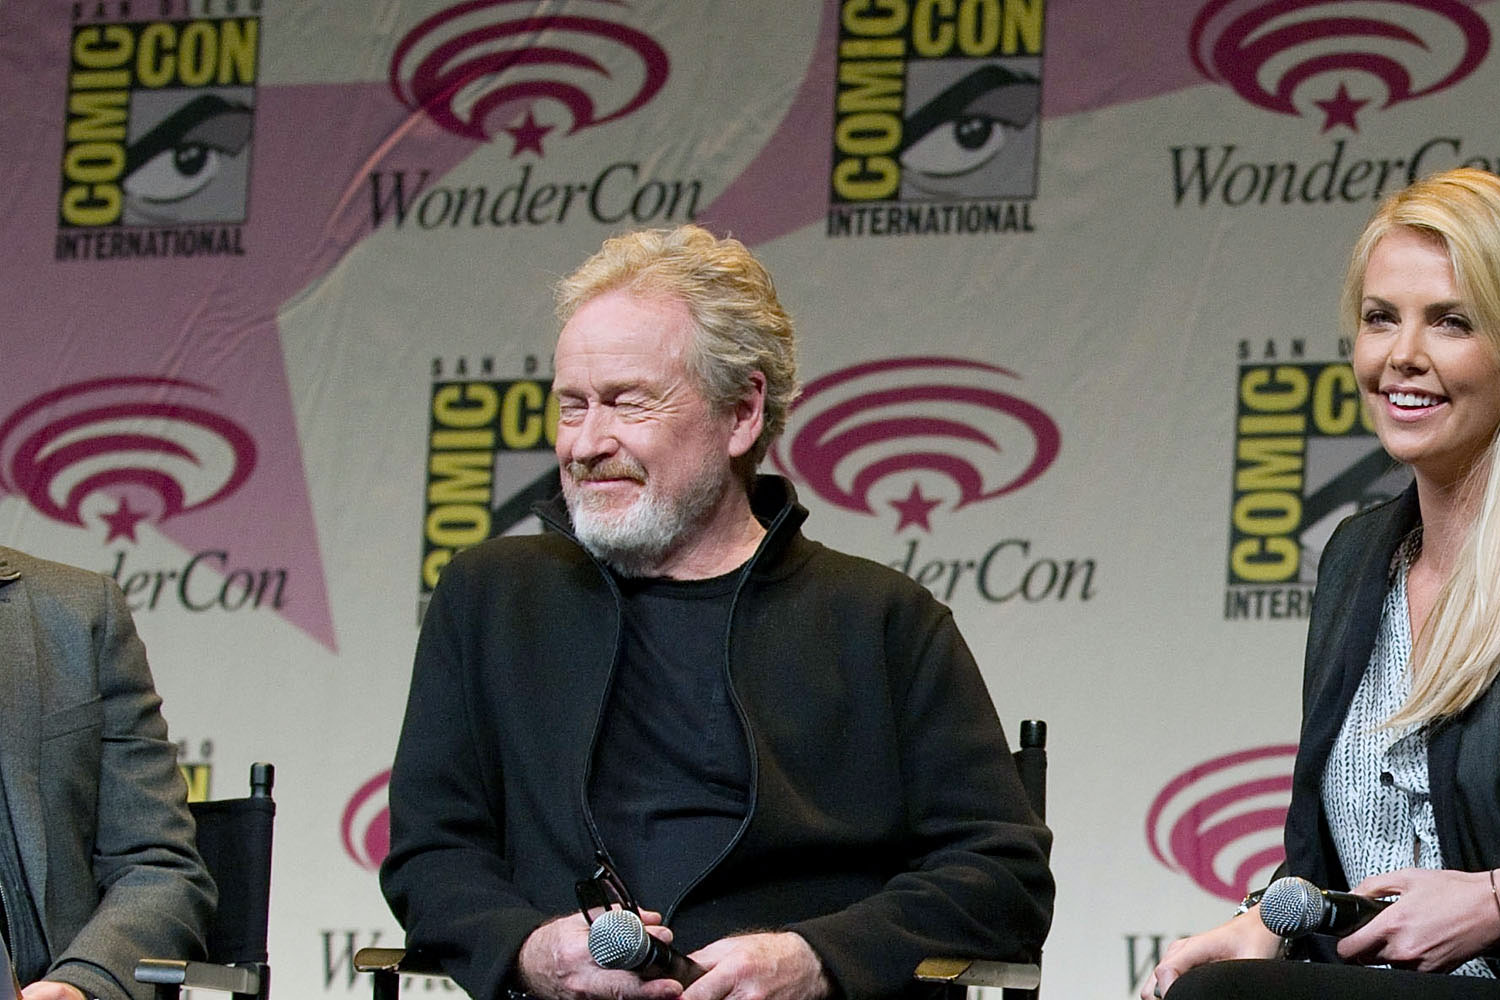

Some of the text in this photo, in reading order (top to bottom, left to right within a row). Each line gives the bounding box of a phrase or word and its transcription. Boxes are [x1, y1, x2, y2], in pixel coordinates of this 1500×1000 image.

[136, 18, 260, 88] CON
[912, 0, 1043, 57] CON
[62, 23, 135, 227] COMIC
[832, 0, 909, 199] COMIC
[368, 161, 703, 230] WonderCon
[826, 203, 1034, 238] INTERNATIONAL
[56, 227, 247, 262] INTERNATIONAL
[432, 355, 496, 376] SAN
[1239, 339, 1305, 360] SAN
[1231, 365, 1310, 582] COMIC
